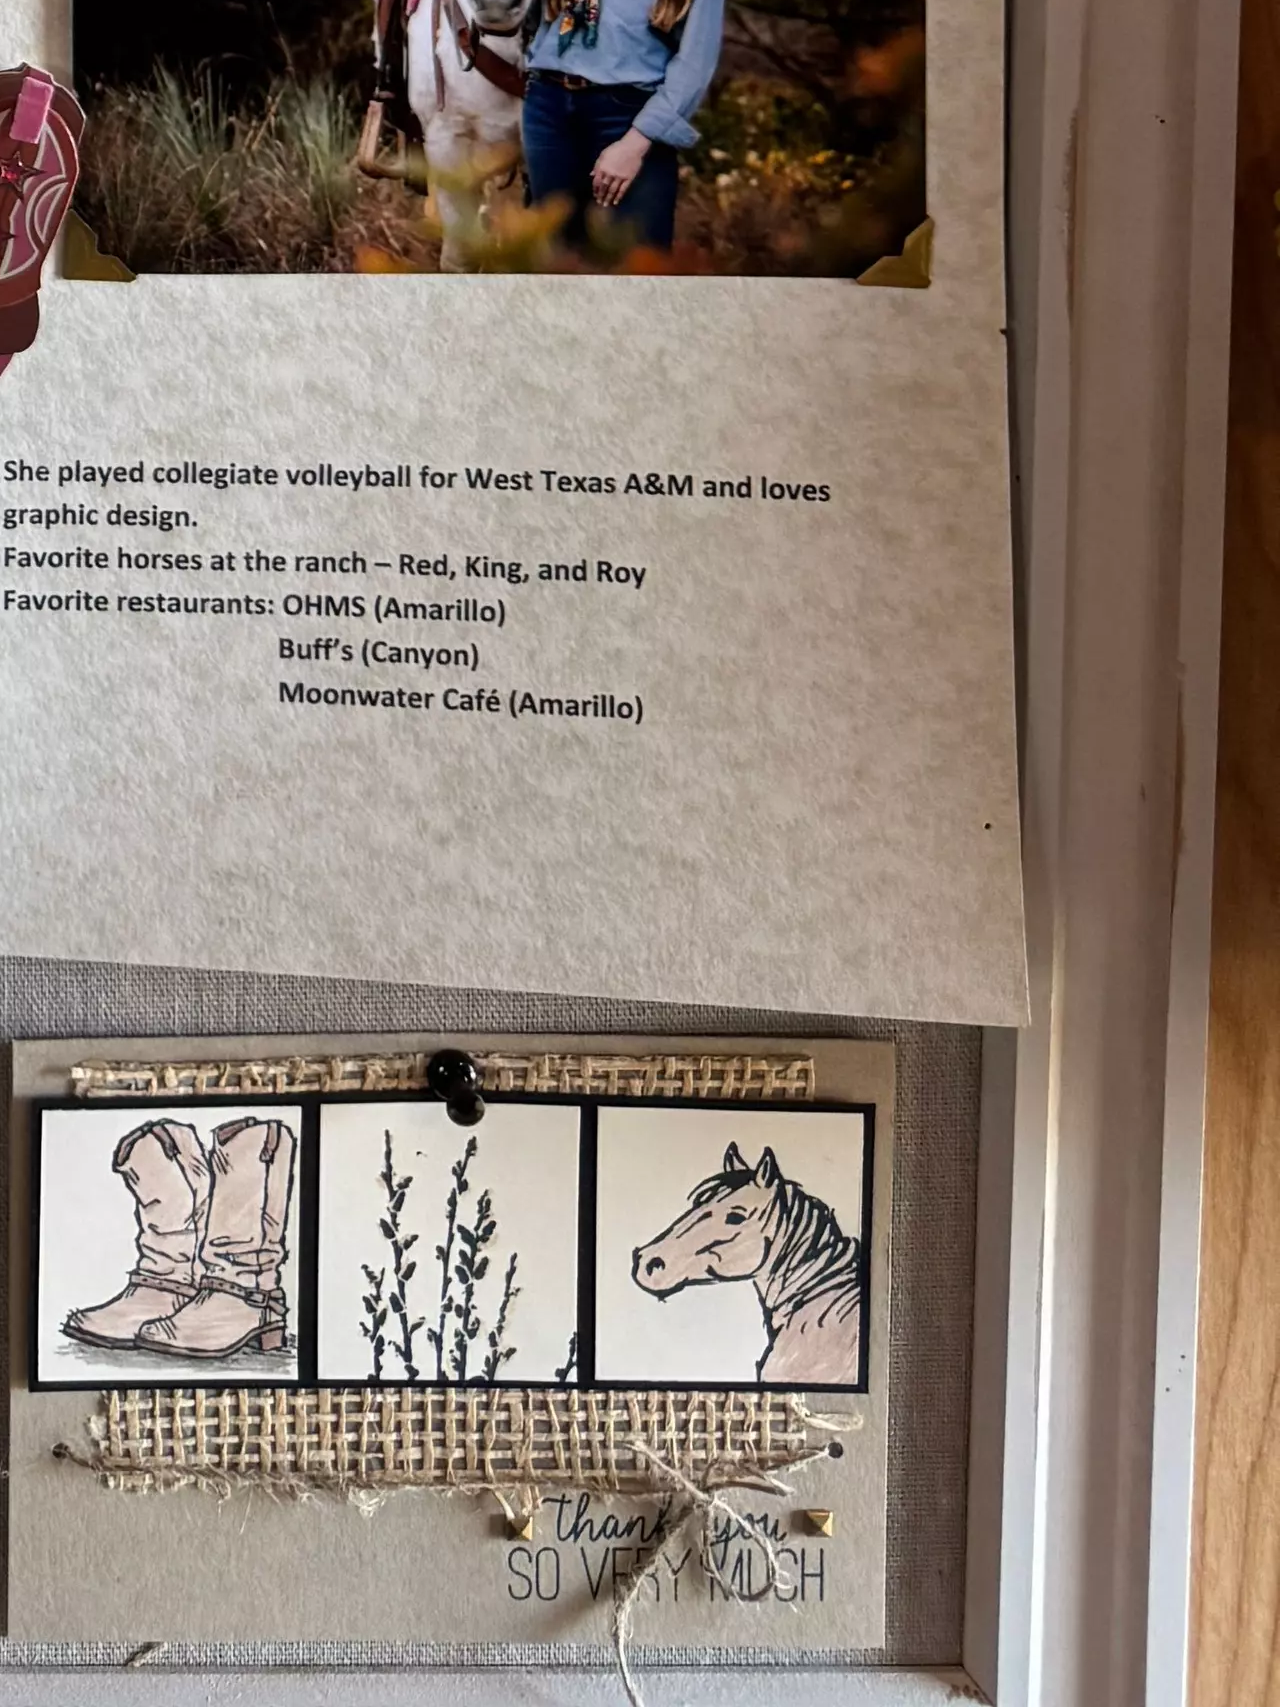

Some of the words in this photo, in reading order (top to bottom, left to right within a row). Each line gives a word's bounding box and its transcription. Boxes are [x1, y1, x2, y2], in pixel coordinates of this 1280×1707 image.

[2, 502, 99, 531] graphic
[106, 503, 198, 533] design.
[279, 637, 354, 662] Buff's
[361, 638, 479, 672] (Canyon)
[279, 681, 436, 710] Moonwater
[442, 688, 501, 713] Café
[509, 689, 643, 726] (Amarillo)
[507, 1546, 561, 1601] SO
